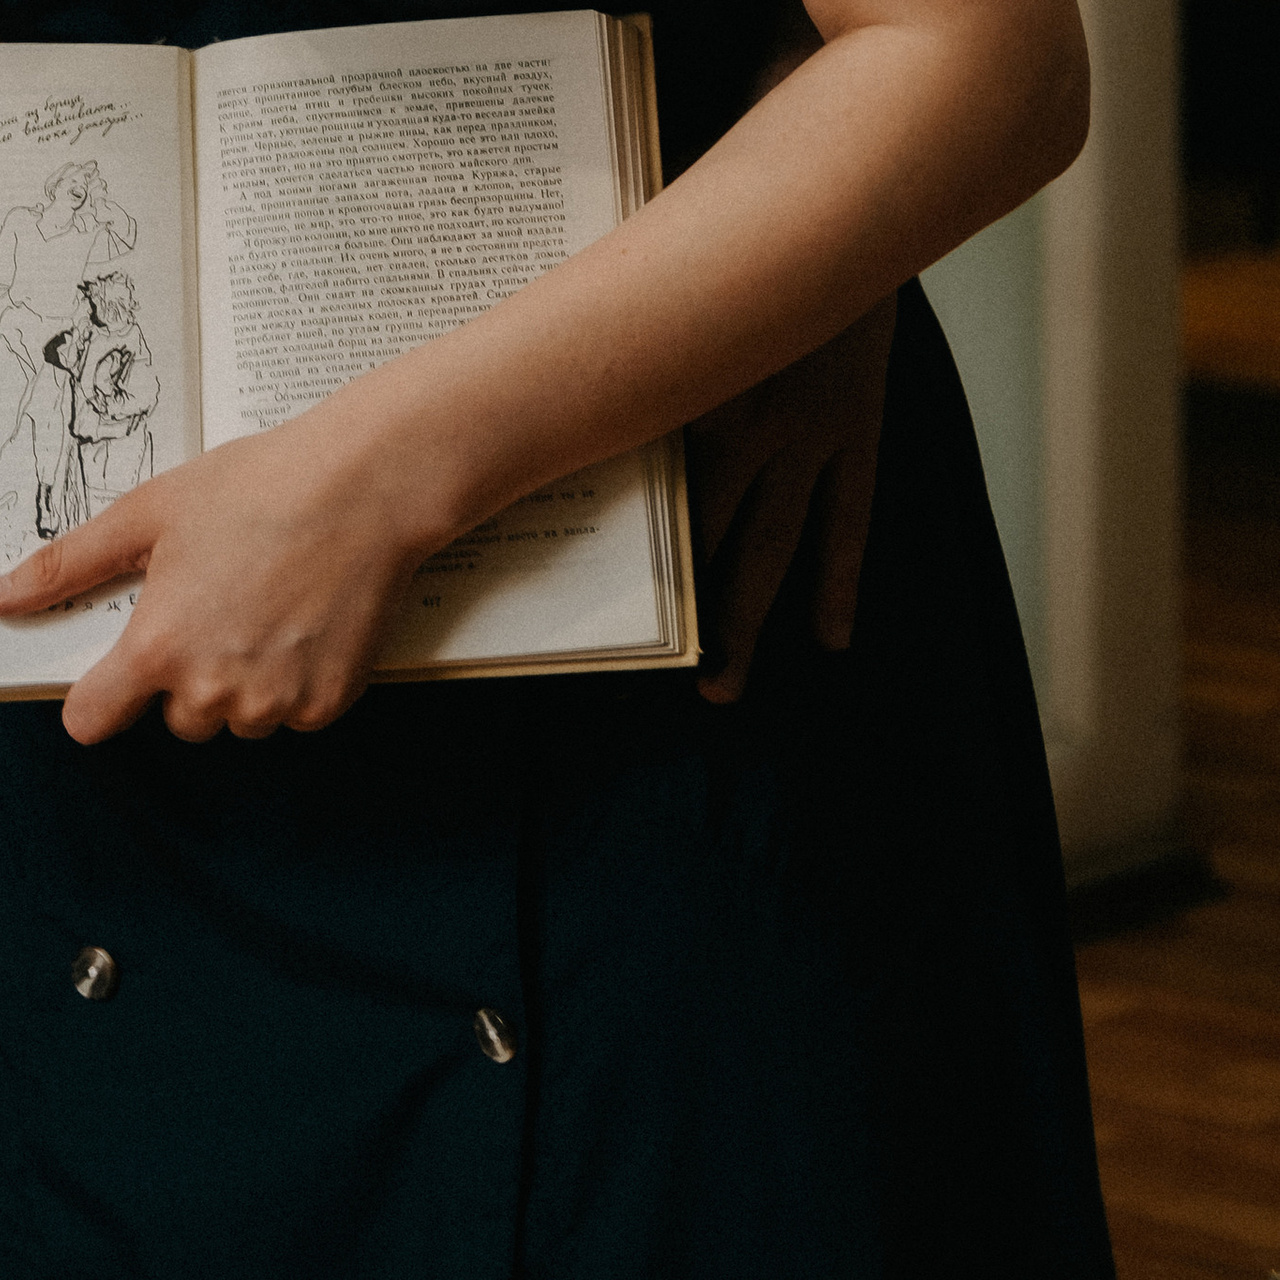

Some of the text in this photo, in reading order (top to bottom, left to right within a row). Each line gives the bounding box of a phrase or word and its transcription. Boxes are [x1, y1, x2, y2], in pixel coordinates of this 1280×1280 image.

[253, 74, 335, 92] горизонтальной
[342, 68, 403, 84] прозрачной
[409, 65, 469, 76] плоскостью
[494, 62, 511, 71] две
[256, 90, 321, 105] пропитанное
[328, 84, 373, 96] голубым
[379, 81, 422, 90] блеском
[430, 77, 456, 86] небо,
[464, 72, 507, 85] вкусный
[514, 71, 552, 81] воздух,
[220, 123, 226, 131] К
[233, 120, 263, 131] краям
[271, 115, 298, 125] неба,
[306, 108, 381, 122] спустившимся
[406, 104, 438, 112] земле,
[446, 99, 504, 111] привешены
[513, 95, 554, 105] далекие
[261, 104, 297, 114] полеты
[306, 101, 330, 109] птиц
[353, 94, 403, 107] гребешки
[411, 90, 454, 100] высоких
[463, 85, 513, 96] покойных
[522, 83, 553, 93] тучек.
[25, 108, 39, 123] из
[257, 131, 276, 139] хат,
[280, 126, 318, 138] уютные
[322, 122, 364, 134] рощицы
[377, 116, 429, 129] уходящая
[433, 113, 472, 124] куда-то
[476, 110, 516, 119] веселая
[519, 105, 555, 115] змейка
[255, 141, 296, 152] Черные,
[301, 136, 342, 145] зеленые
[359, 131, 394, 142] рыжие
[457, 124, 486, 134] перед
[491, 119, 556, 132] праздником,
[276, 148, 335, 163] разложены
[339, 146, 358, 154] под
[362, 142, 408, 152] солнцем.
[413, 138, 455, 149] Хорошо
[502, 133, 520, 141] или
[524, 131, 558, 139] плохо,
[233, 180, 269, 189] милым,
[275, 174, 314, 184] хочется
[319, 169, 372, 180] сделаться
[377, 166, 415, 174] частью
[420, 162, 455, 171] ясного
[460, 158, 508, 168] майского
[513, 157, 534, 165] дня.
[259, 165, 291, 174] знает,
[346, 156, 389, 167] приятно
[393, 151, 443, 162] смотреть,
[467, 146, 511, 155] кажется
[514, 142, 559, 154] простым
[240, 166, 561, 200] А под моими ногами загаженная почва Куряжа, старые
[261, 197, 329, 212] пропитанные
[335, 193, 379, 202] запахом
[385, 190, 413, 198] пота,
[418, 186, 456, 196] ладана
[474, 182, 514, 191] клопов,
[520, 178, 563, 187] вековые
[294, 209, 324, 218] попов
[338, 202, 415, 216] кровоточащая
[419, 199, 447, 209] грязь
[451, 193, 534, 205] беспризорщины.
[541, 189, 563, 198] Нет,
[228, 254, 245, 262] как
[249, 250, 278, 261] будто
[282, 244, 340, 256] становится
[391, 237, 413, 245] Они
[417, 233, 476, 243] наблюдают
[497, 227, 523, 237] мной
[528, 226, 567, 235] издали.
[230, 277, 252, 286] вить
[257, 272, 282, 282] себе,
[288, 272, 308, 280] где,
[314, 267, 360, 276] наконец,
[389, 261, 429, 270] спален,
[434, 257, 477, 266] сколько
[482, 253, 528, 264] десятков
[233, 313, 262, 322] голых
[267, 308, 303, 319] досках
[320, 302, 372, 312] железных
[378, 298, 425, 307] полосках
[431, 291, 481, 305] кроватей.
[283, 339, 334, 352] холодный
[338, 338, 367, 348] борщ
[237, 358, 290, 371] обращают
[295, 353, 344, 363] никакого
[256, 371, 262, 379] В
[270, 367, 301, 379] одной
[326, 363, 362, 372] спален
